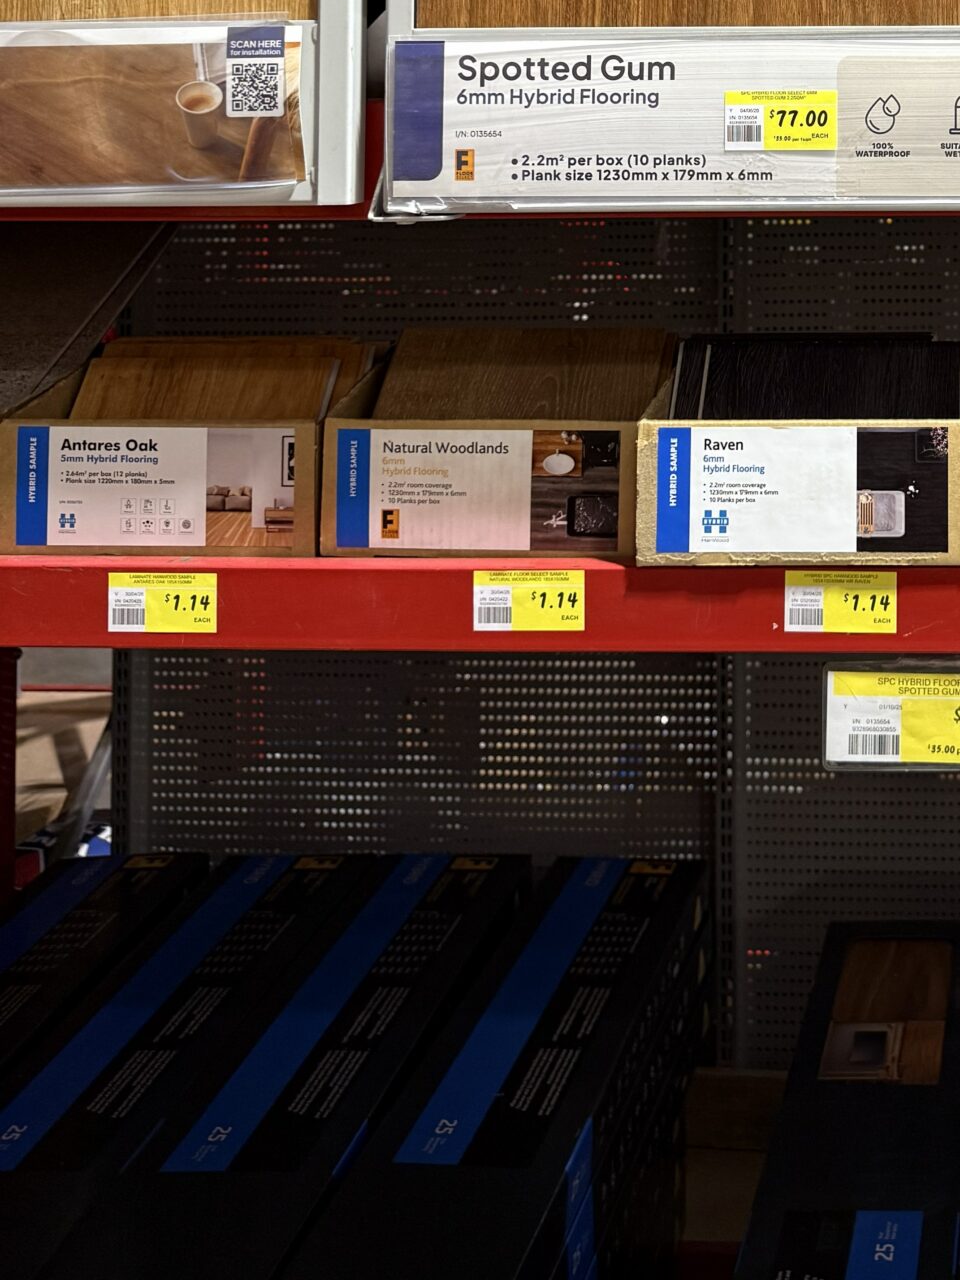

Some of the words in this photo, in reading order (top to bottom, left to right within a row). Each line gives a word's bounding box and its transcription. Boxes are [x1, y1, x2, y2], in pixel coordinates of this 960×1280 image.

[230, 40, 256, 49] SCAN
[258, 40, 282, 49] HERE
[457, 55, 592, 87] Spotted
[600, 55, 677, 82] Gum
[456, 89, 505, 105] 6mm
[510, 89, 576, 109] Hybrid
[580, 88, 660, 109] Flooring
[769, 108, 828, 128] $77.00
[470, 130, 502, 138] 0135654
[872, 142, 894, 150] 100%
[567, 157, 592, 169] per
[595, 154, 624, 167] box
[627, 154, 650, 169] (10
[653, 154, 707, 169] planks)
[855, 150, 911, 158] WATERPROOF
[521, 170, 562, 181] Plank
[565, 170, 593, 181] size
[596, 169, 659, 181] 1230mm
[674, 169, 723, 181] 179mm
[738, 169, 774, 181] 6mm
[61, 438, 122, 453] Antares
[125, 438, 159, 453] Oak
[383, 440, 433, 455] Natural
[436, 441, 510, 455] Woodlands
[703, 438, 745, 452] Raven
[28, 436, 37, 470] SAMPLE
[61, 455, 85, 463] 5mm
[86, 454, 118, 465] Hybrid
[120, 454, 159, 465] Flooring
[350, 439, 358, 468] SAMPLE
[669, 437, 678, 473] SAMPLE
[703, 454, 725, 463] 6mm
[382, 456, 406, 466] 6mm
[382, 467, 412, 478] Hybrid
[413, 467, 449, 478] Flooring
[703, 464, 731, 475] Hybrid
[732, 464, 766, 475] Flooring
[28, 471, 36, 504] HYBRID
[350, 469, 358, 497] HYBRID
[668, 475, 677, 508] HYBRID
[165, 593, 211, 612] $1.14
[531, 590, 579, 609] $1.14
[843, 593, 891, 613] $1.14
[560, 614, 579, 622] EACH
[877, 677, 897, 687] SPC
[898, 678, 932, 687] HYBRID
[898, 686, 940, 696] SPOTTED
[875, 1243, 895, 1261] 25
